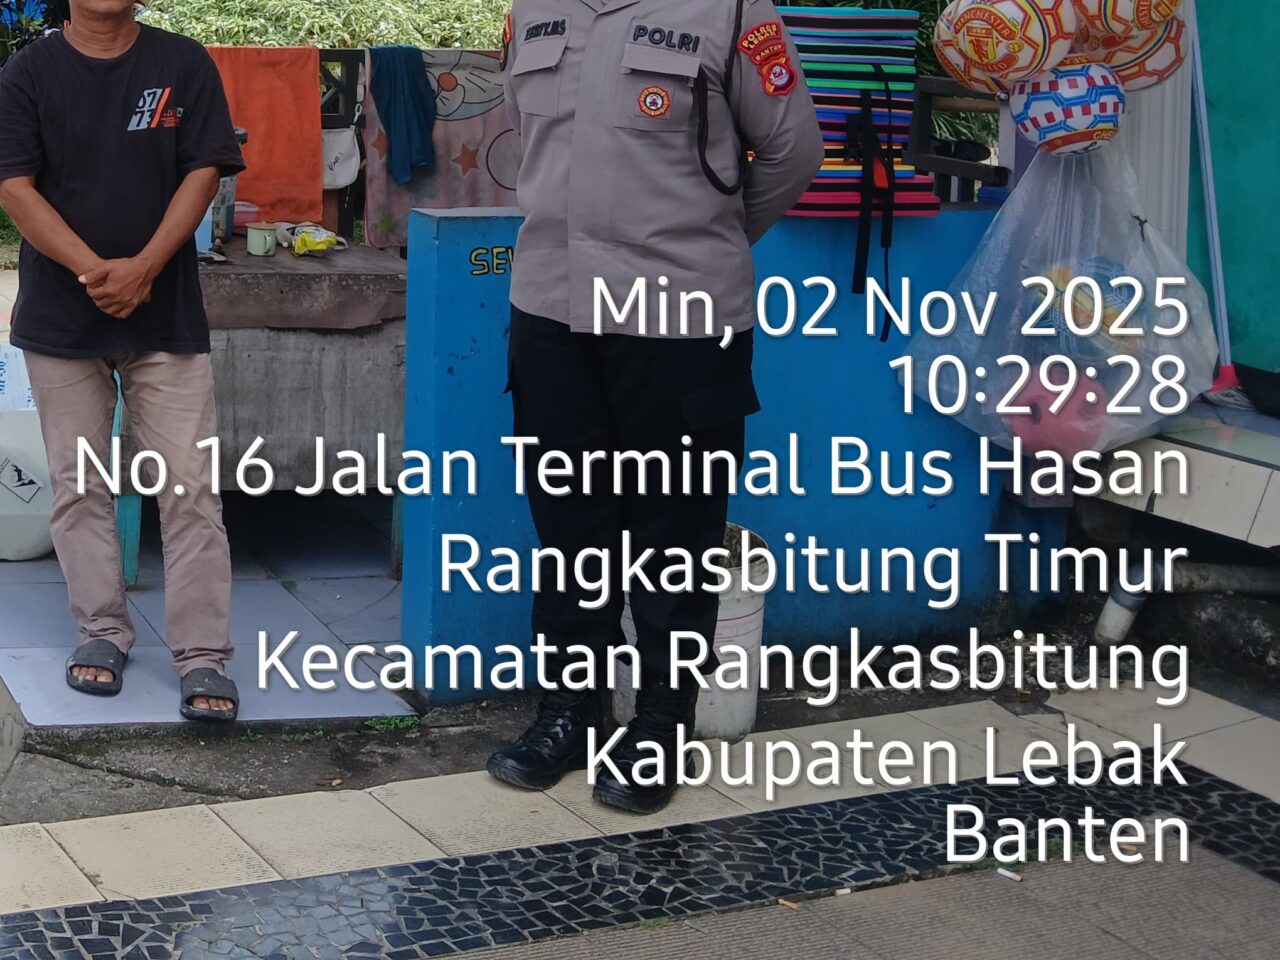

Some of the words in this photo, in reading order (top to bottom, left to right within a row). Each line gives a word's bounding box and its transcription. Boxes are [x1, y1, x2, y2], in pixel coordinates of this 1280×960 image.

[633, 25, 700, 53] POLRI
[742, 24, 777, 48] POLRES
[755, 44, 782, 61] BANTEN
